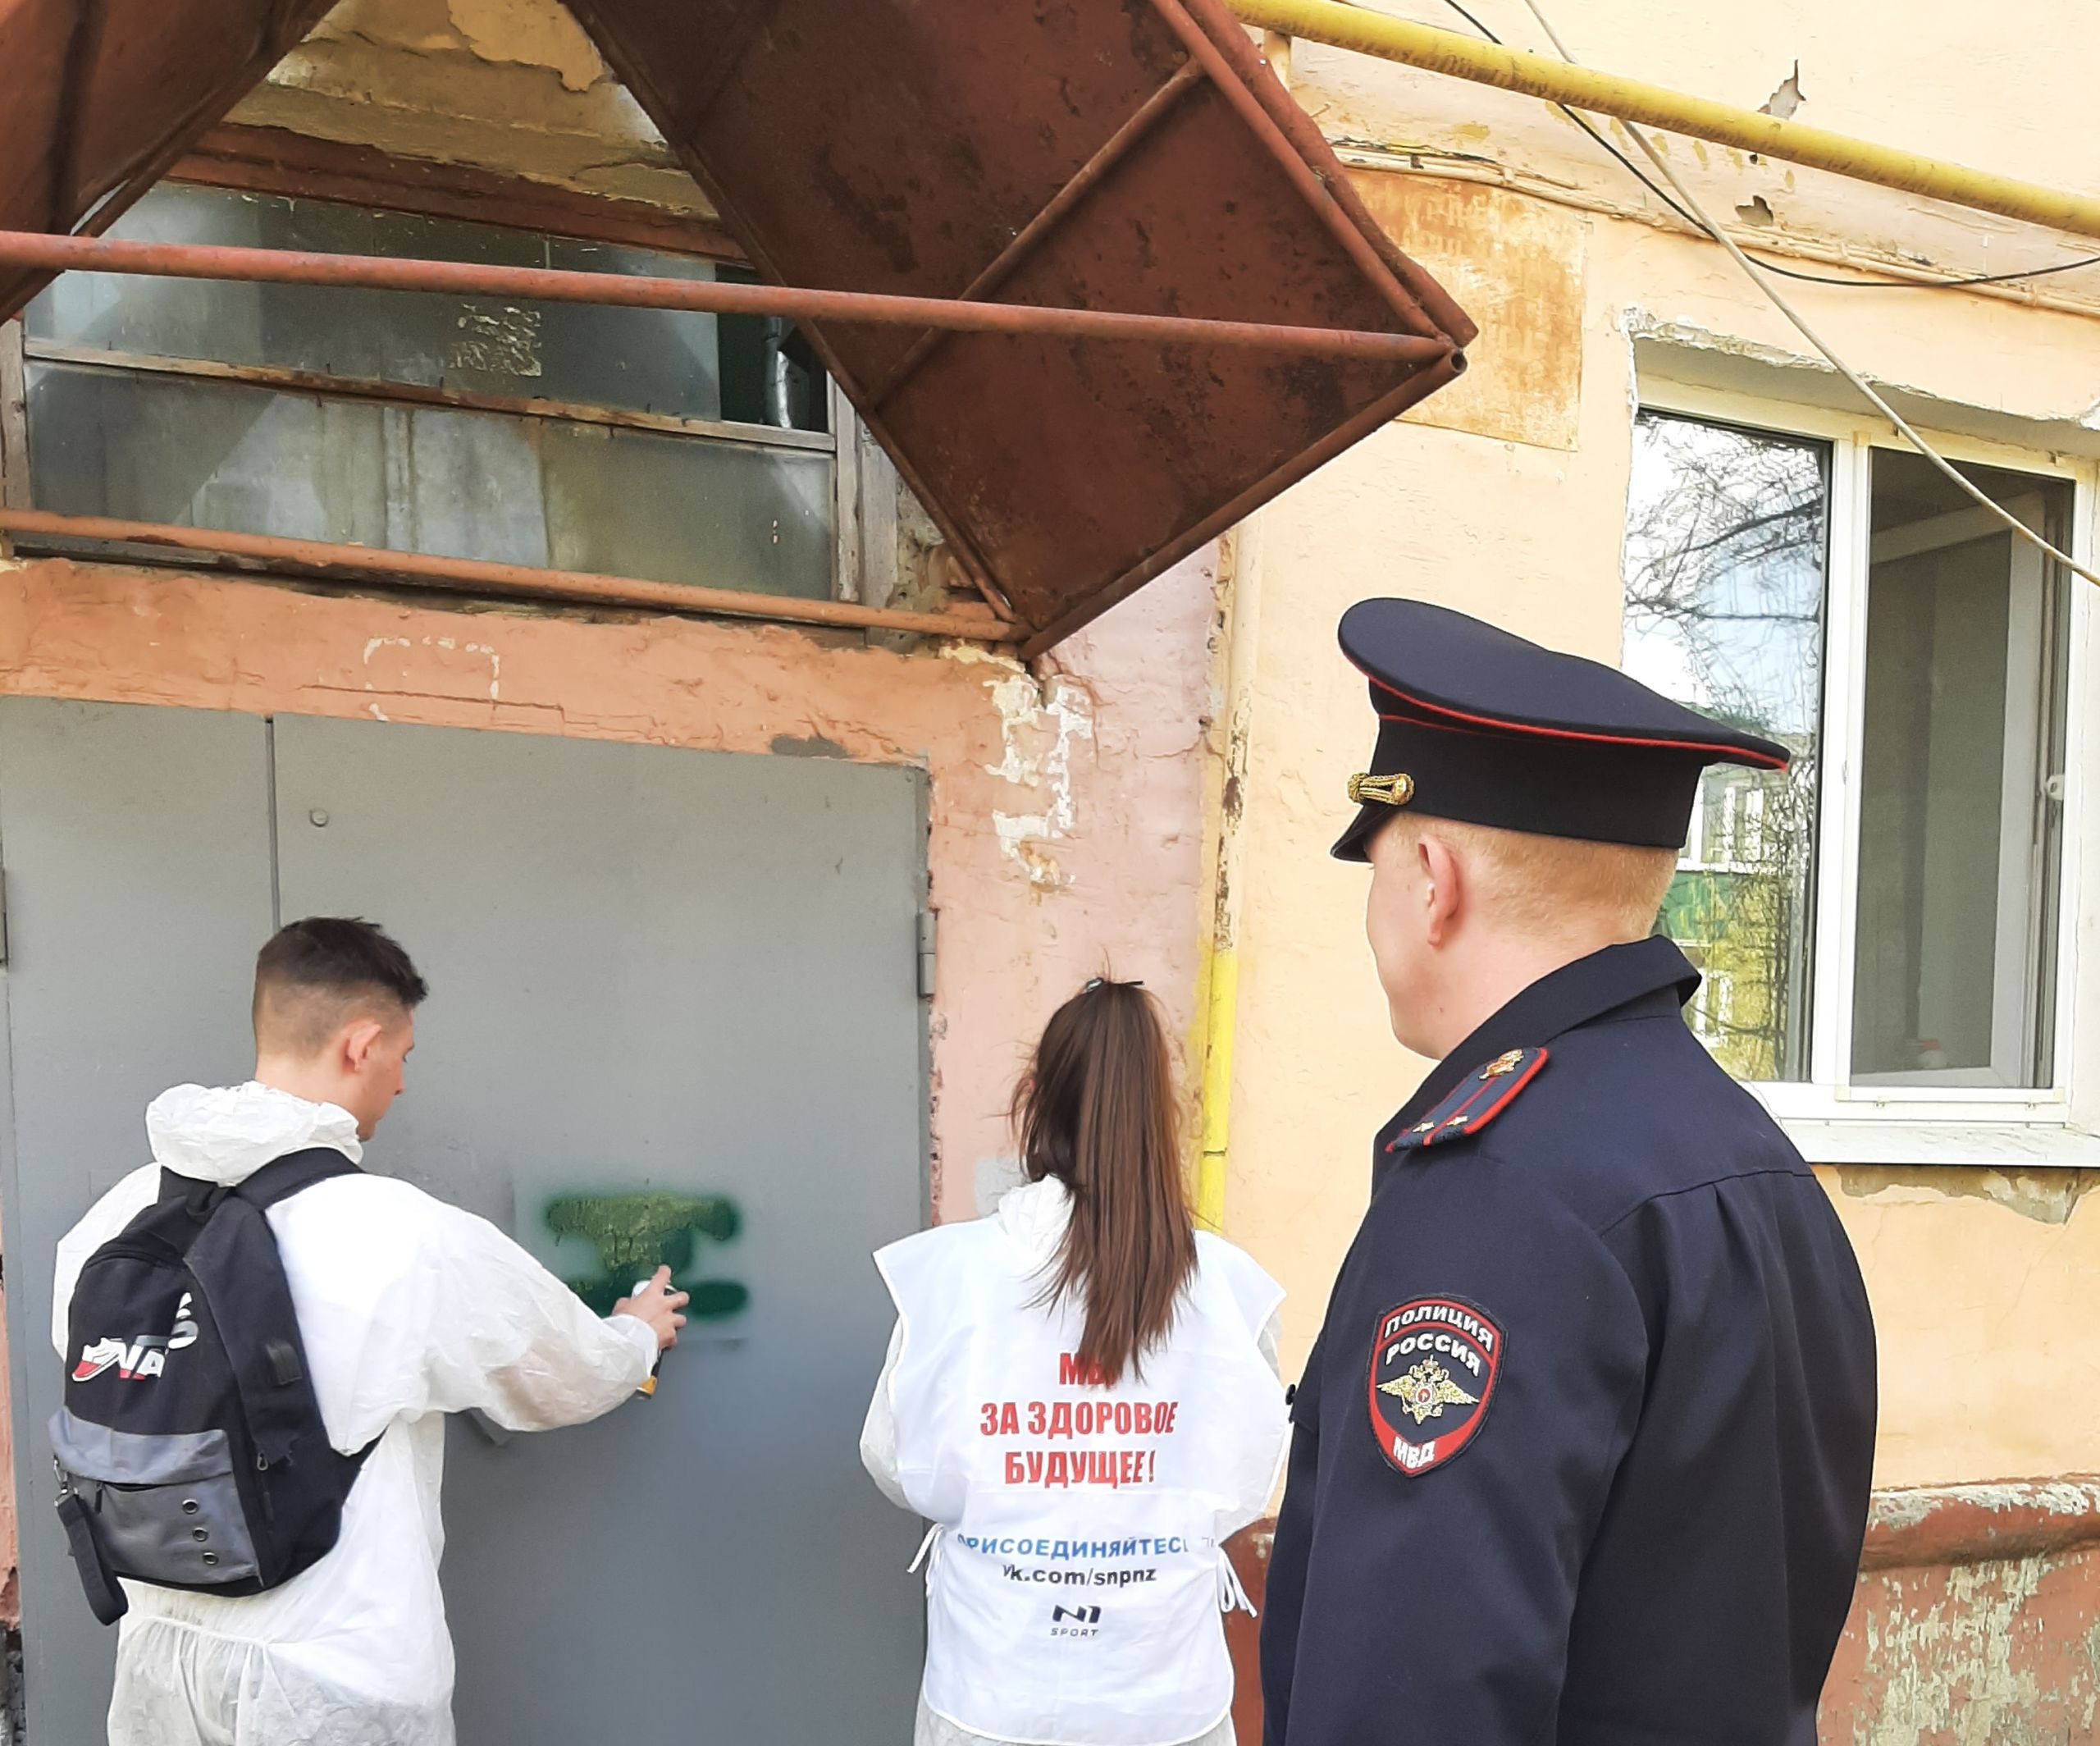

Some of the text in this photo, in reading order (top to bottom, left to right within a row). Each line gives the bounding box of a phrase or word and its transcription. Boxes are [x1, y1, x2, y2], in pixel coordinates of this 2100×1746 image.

[1384, 1305, 1494, 1351] ПОЛИЦИЯ
[1386, 1332, 1481, 1377] РОССИЯ
[980, 1401, 1178, 1440] ЗА ЗДОРОВОЕ
[1005, 1450, 1156, 1489] БУДУЩЕЕ!
[1393, 1436, 1436, 1469] МВД
[1002, 1563, 1157, 1588] vk.com/snpnz
[1050, 1627, 1098, 1637] SPORT
